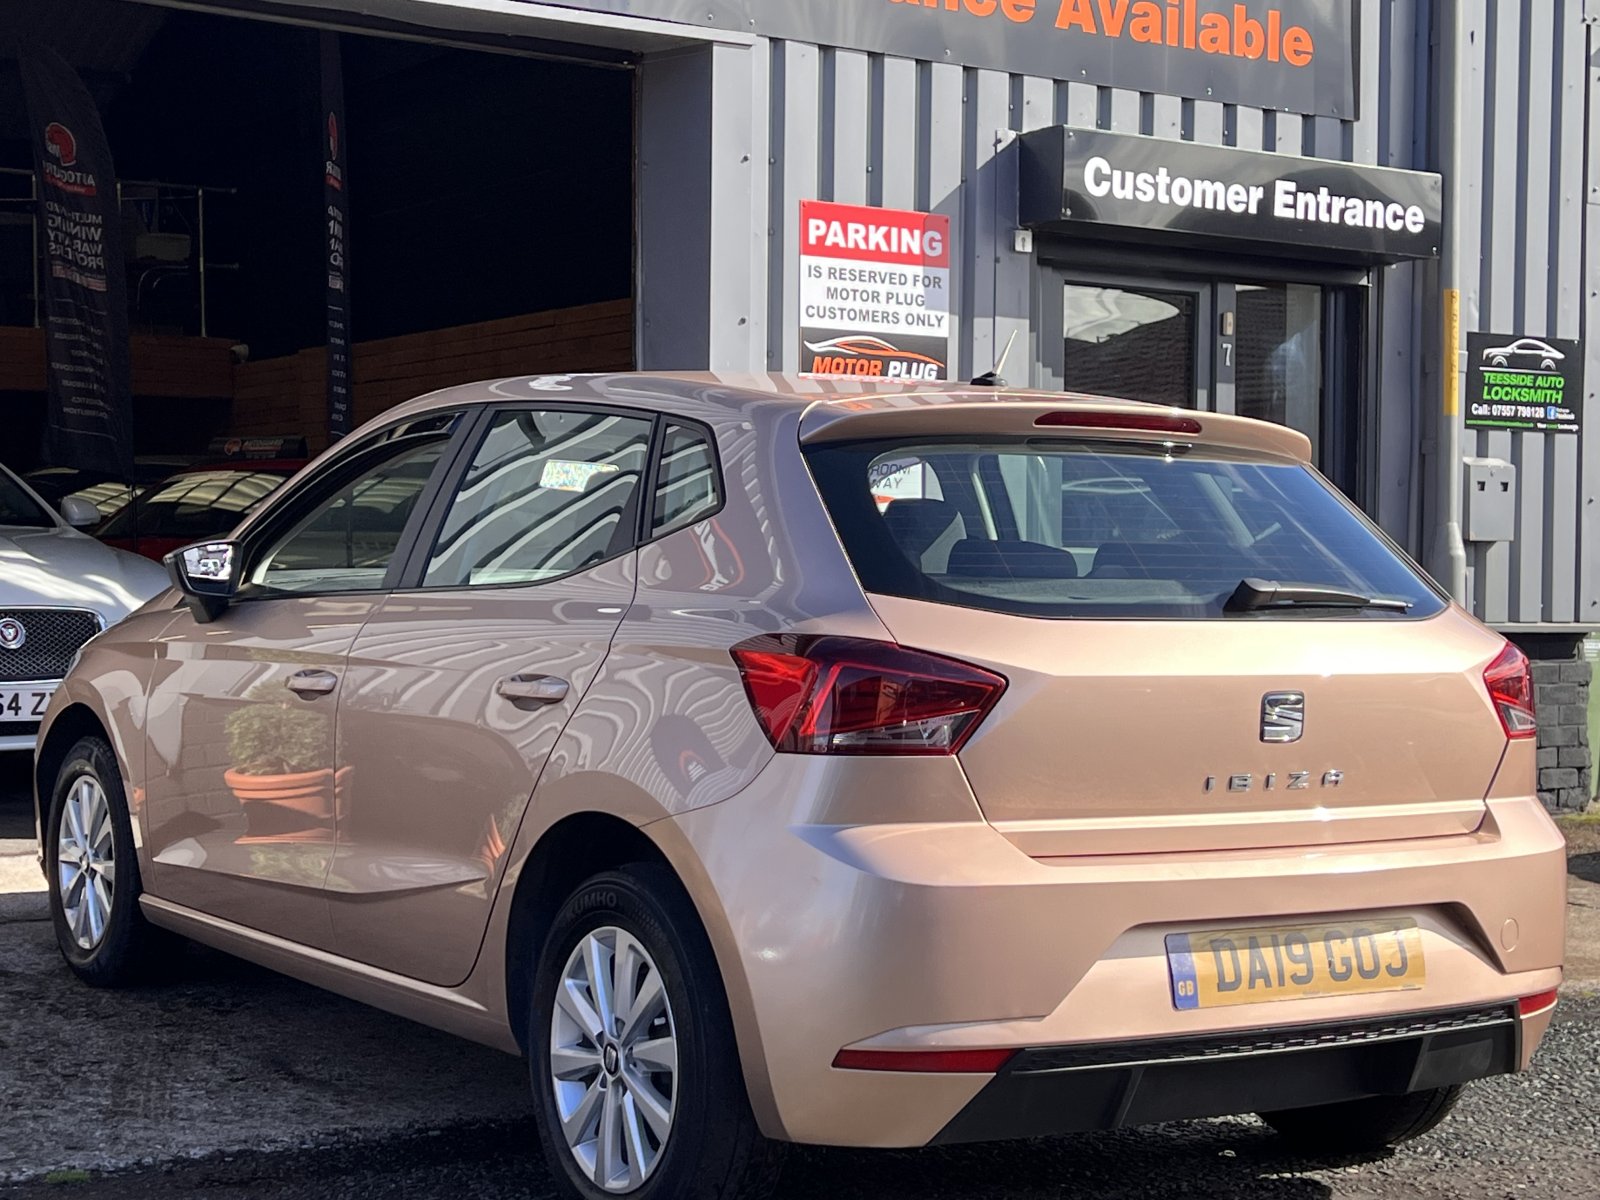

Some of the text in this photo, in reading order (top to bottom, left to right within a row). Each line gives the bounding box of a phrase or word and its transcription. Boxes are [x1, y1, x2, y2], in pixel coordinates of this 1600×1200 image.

[1055, 0, 1314, 66] Available
[1083, 156, 1426, 234] Customer Entrance
[807, 218, 943, 257] PARKING
[807, 264, 942, 289] IS RESERVED FOR
[826, 286, 925, 307] MOTOR PLUG
[805, 305, 944, 328] CUSTOMERS ONLY
[1222, 343, 1232, 366] 7
[812, 356, 938, 380] MOTOR PLUG
[1483, 372, 1565, 389] TEESSIDE AUTO
[1482, 386, 1563, 404] LOCKSMITH
[1471, 403, 1491, 416] Call:
[1202, 769, 1345, 795] IBIZA
[1210, 930, 1314, 993] DA19
[1177, 980, 1195, 997] GB
